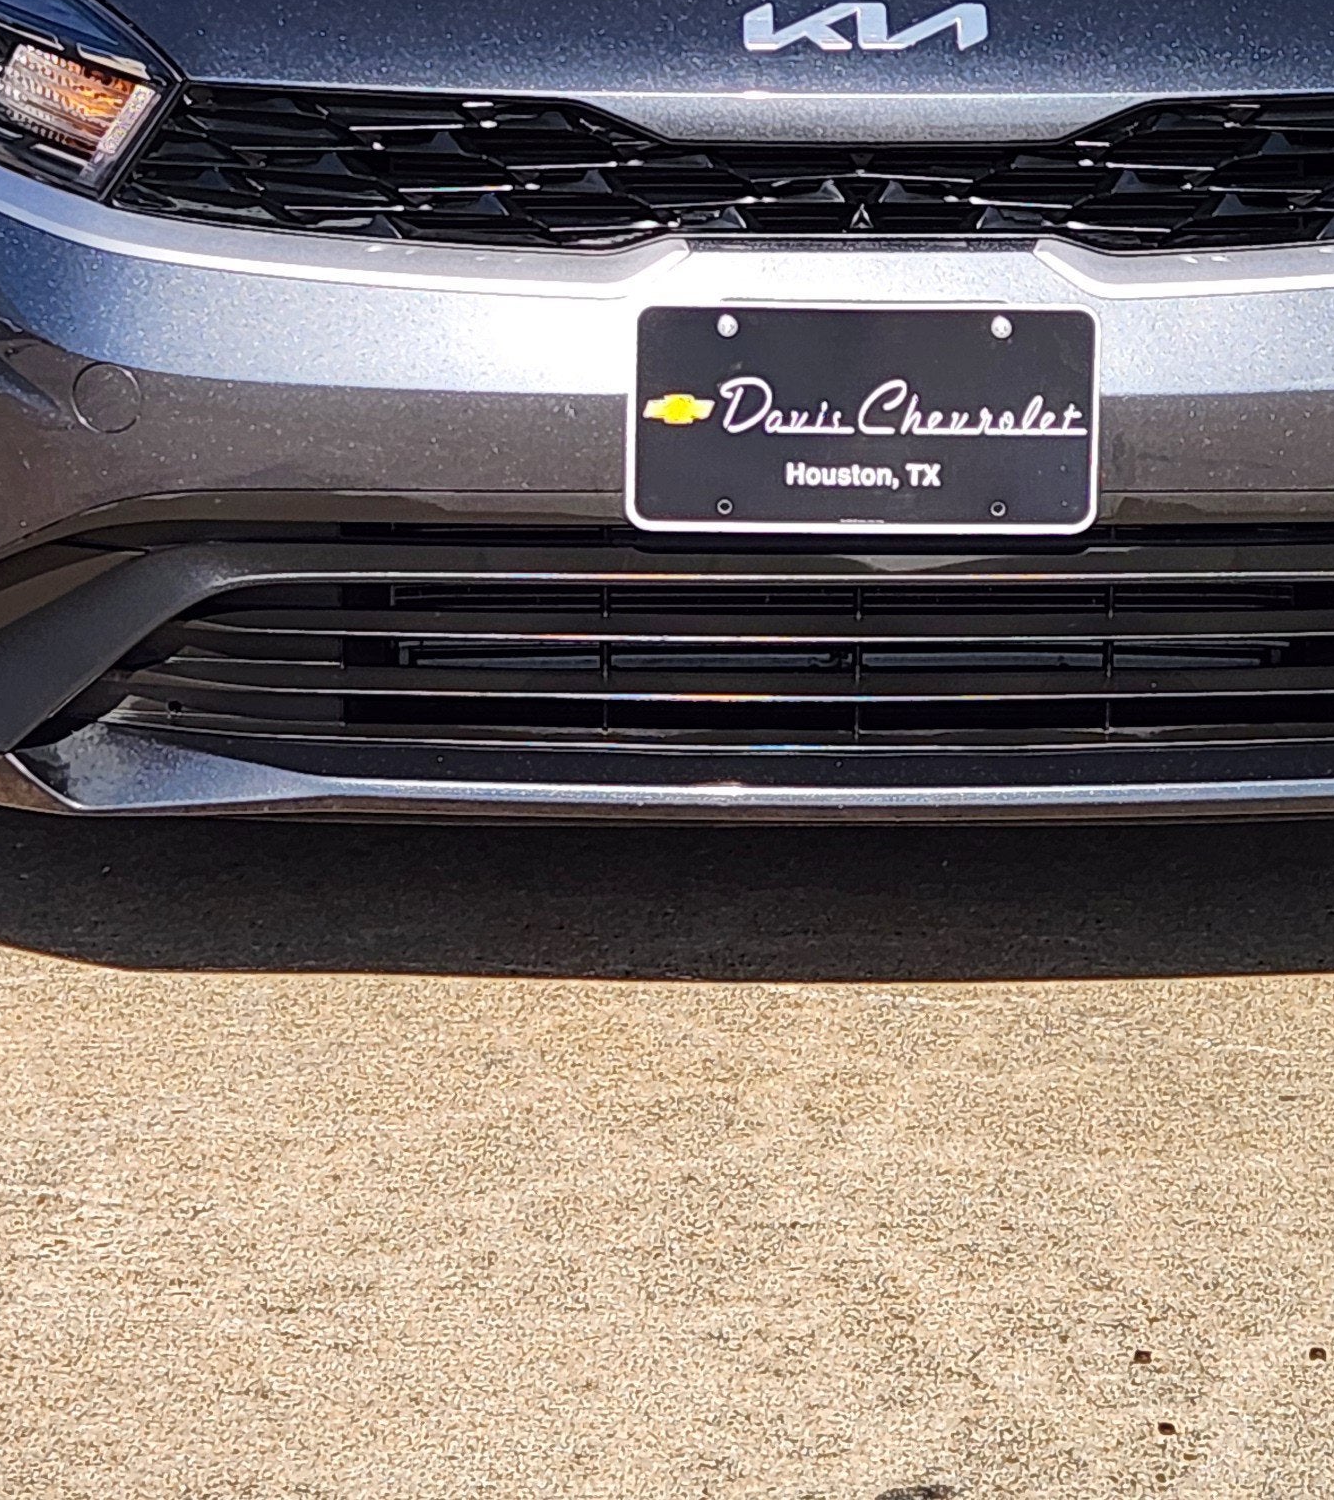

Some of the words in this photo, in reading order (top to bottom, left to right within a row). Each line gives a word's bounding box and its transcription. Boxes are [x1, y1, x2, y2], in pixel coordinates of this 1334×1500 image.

[718, 375, 855, 435] Davis
[857, 378, 1089, 436] Chevrolet
[785, 461, 900, 490] Houston,
[904, 462, 942, 487] TX
